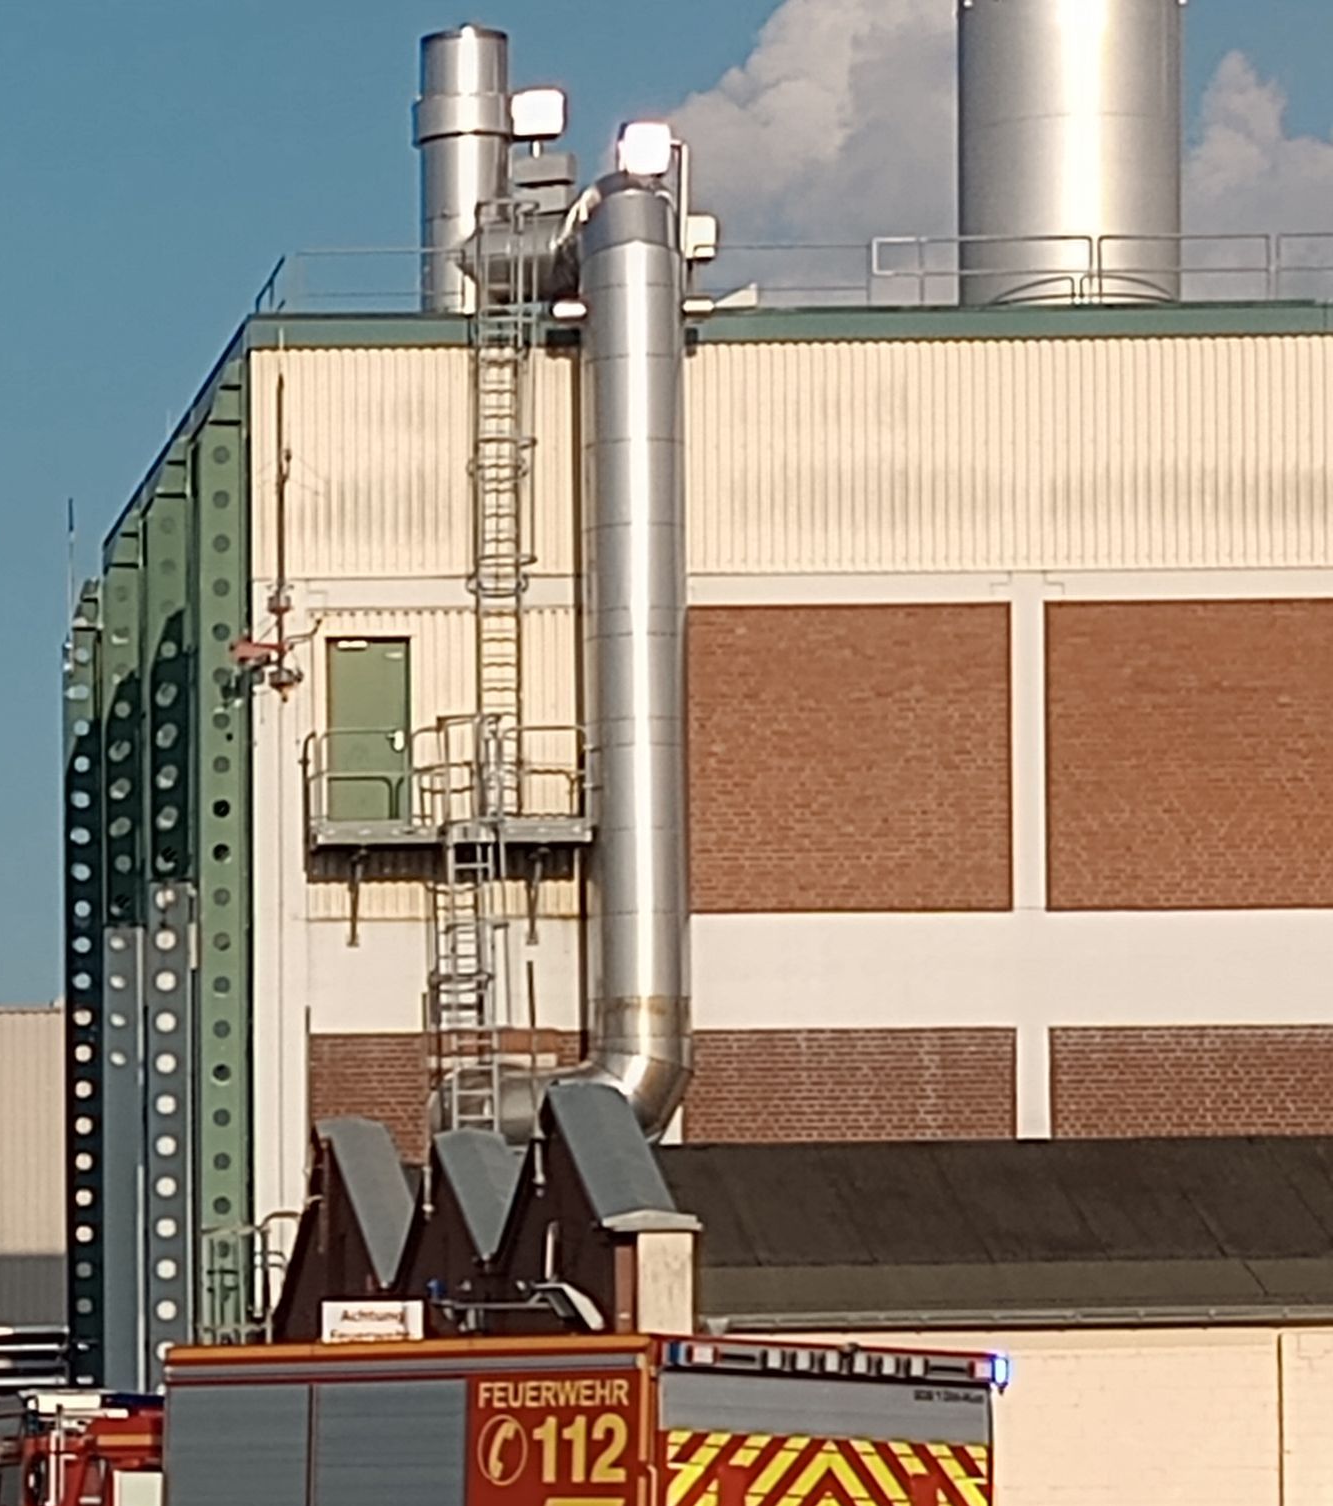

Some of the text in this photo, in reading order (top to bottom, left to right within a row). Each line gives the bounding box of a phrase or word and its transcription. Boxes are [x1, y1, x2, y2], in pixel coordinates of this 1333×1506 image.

[341, 1308, 406, 1324] Achtung
[478, 1378, 630, 1409] FEUERWEHR
[532, 1412, 628, 1484] 112
